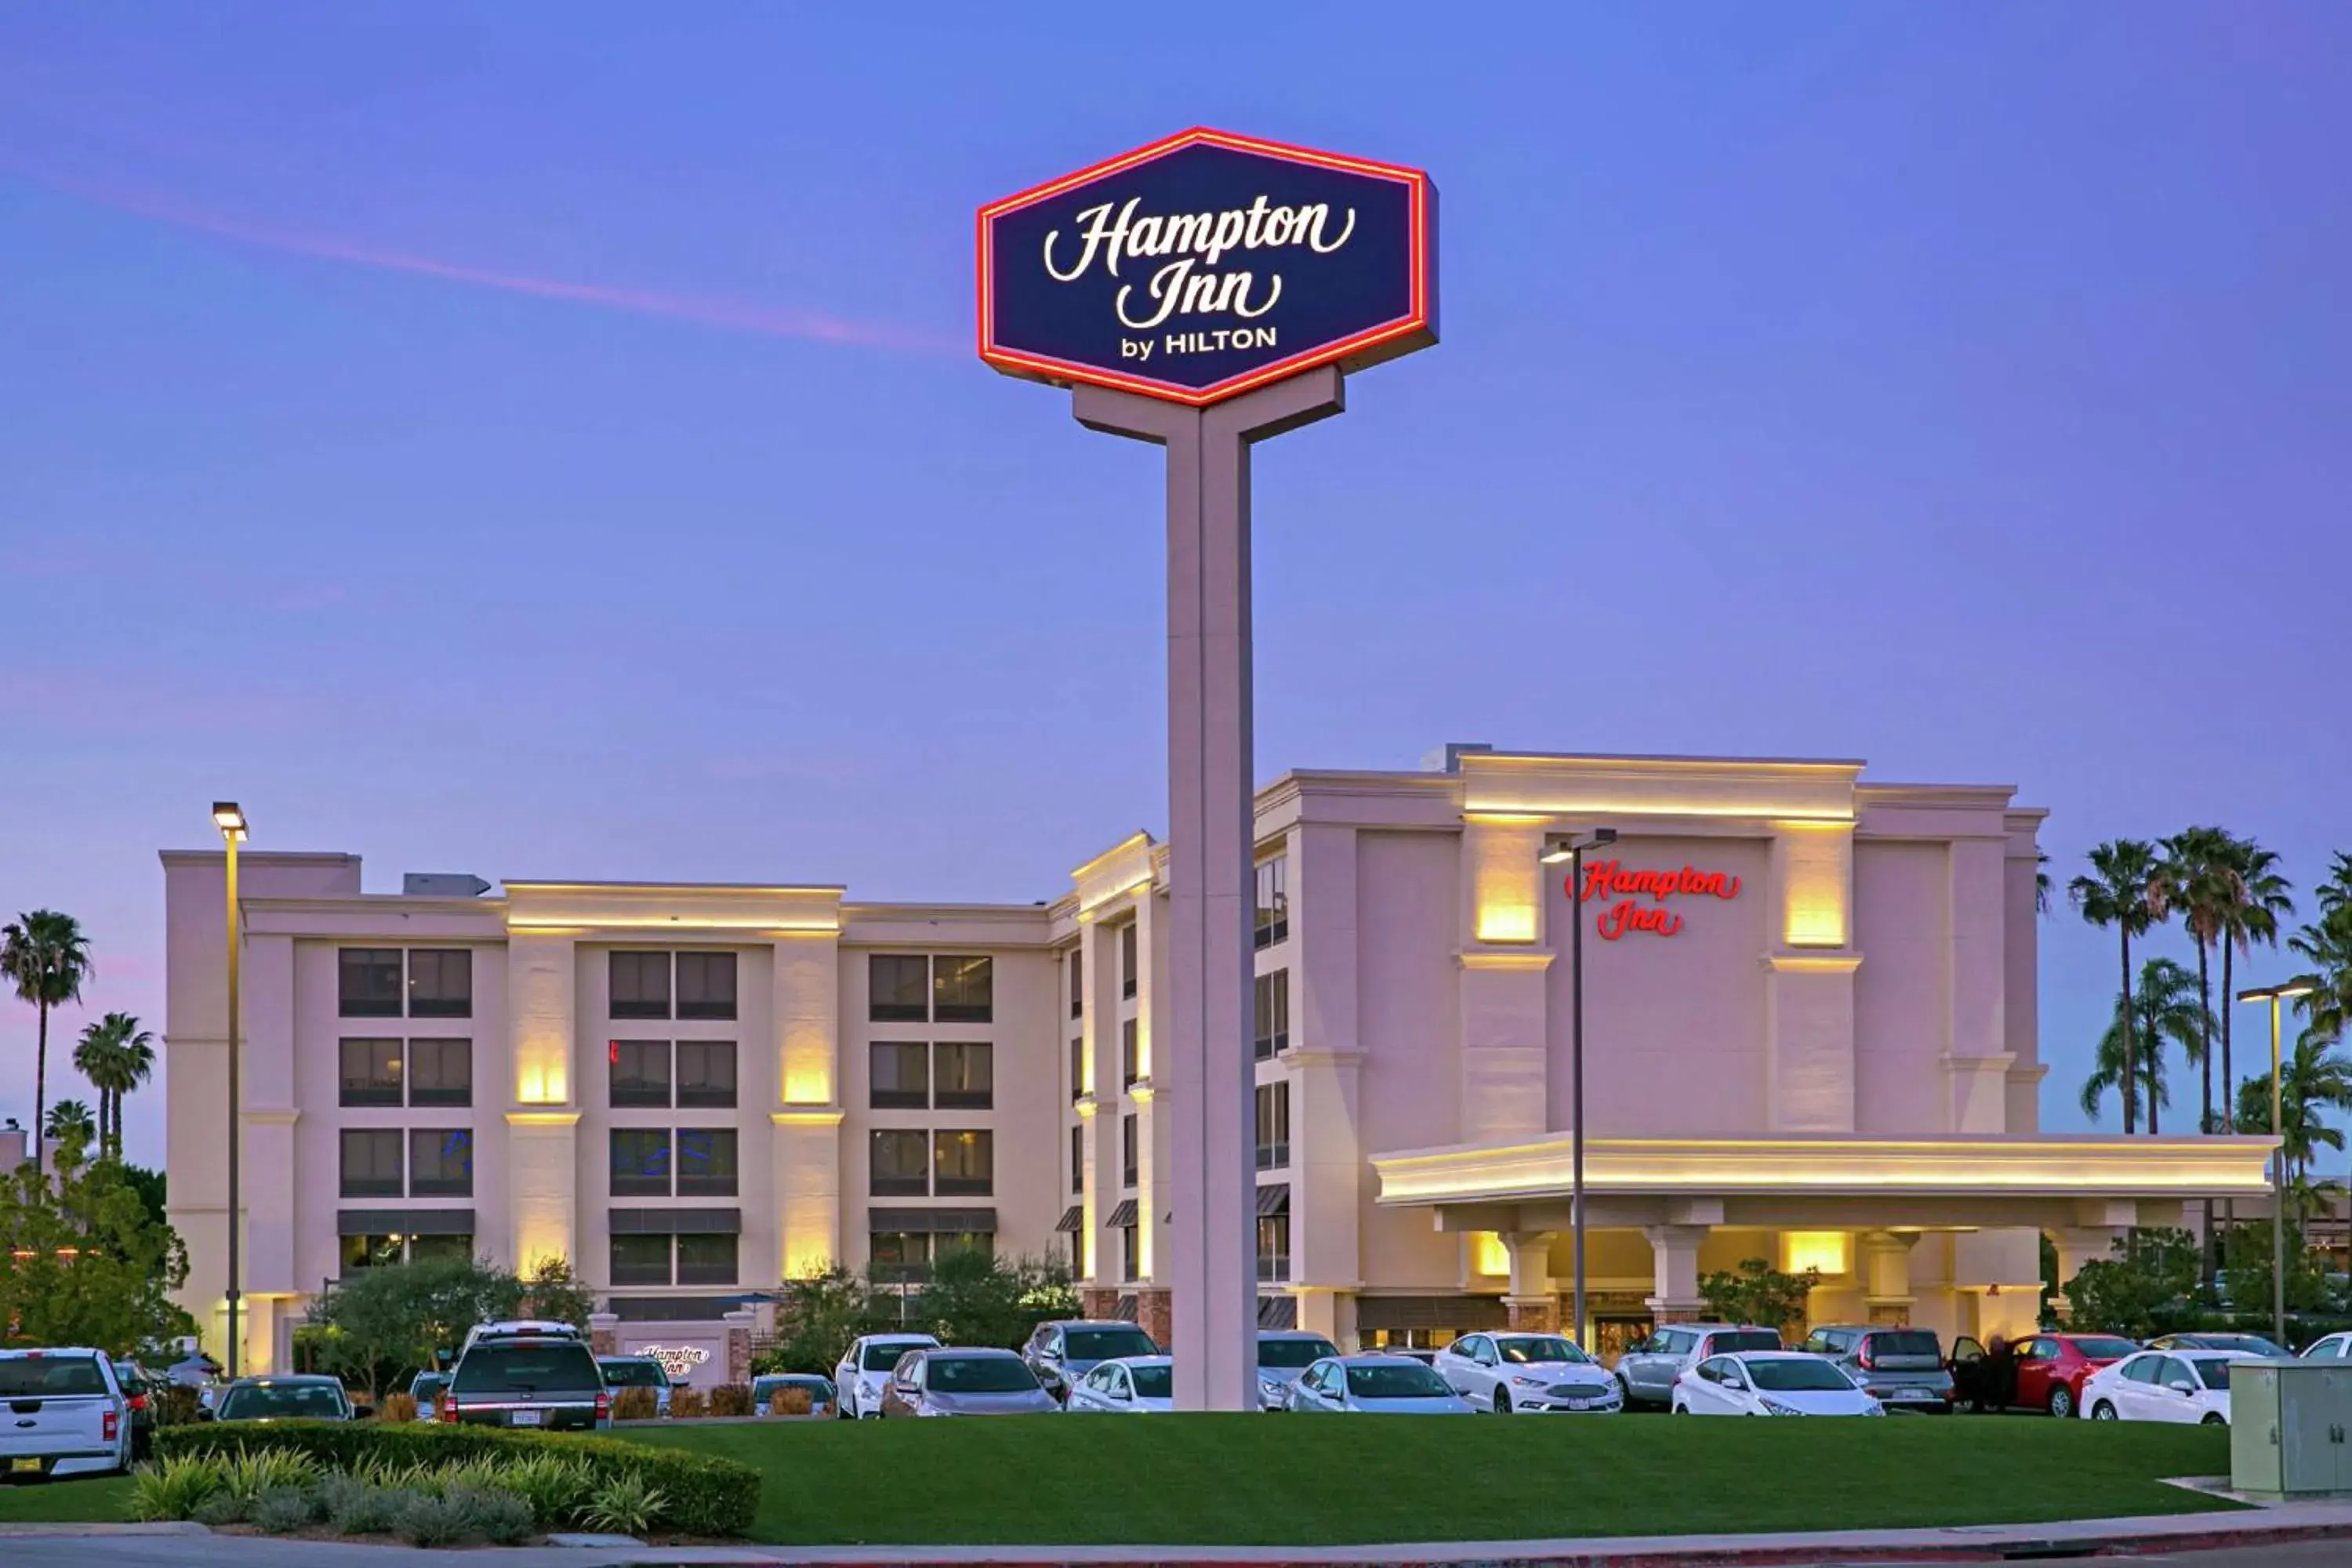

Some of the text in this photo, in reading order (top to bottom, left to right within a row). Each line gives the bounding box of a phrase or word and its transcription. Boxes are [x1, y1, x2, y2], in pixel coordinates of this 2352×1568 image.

[1044, 195, 1356, 281] Hampton
[1116, 258, 1282, 328] Inn
[1122, 327, 1277, 361] by HILTON
[1564, 859, 1742, 902] Hampton
[1596, 898, 1683, 941] Inn
